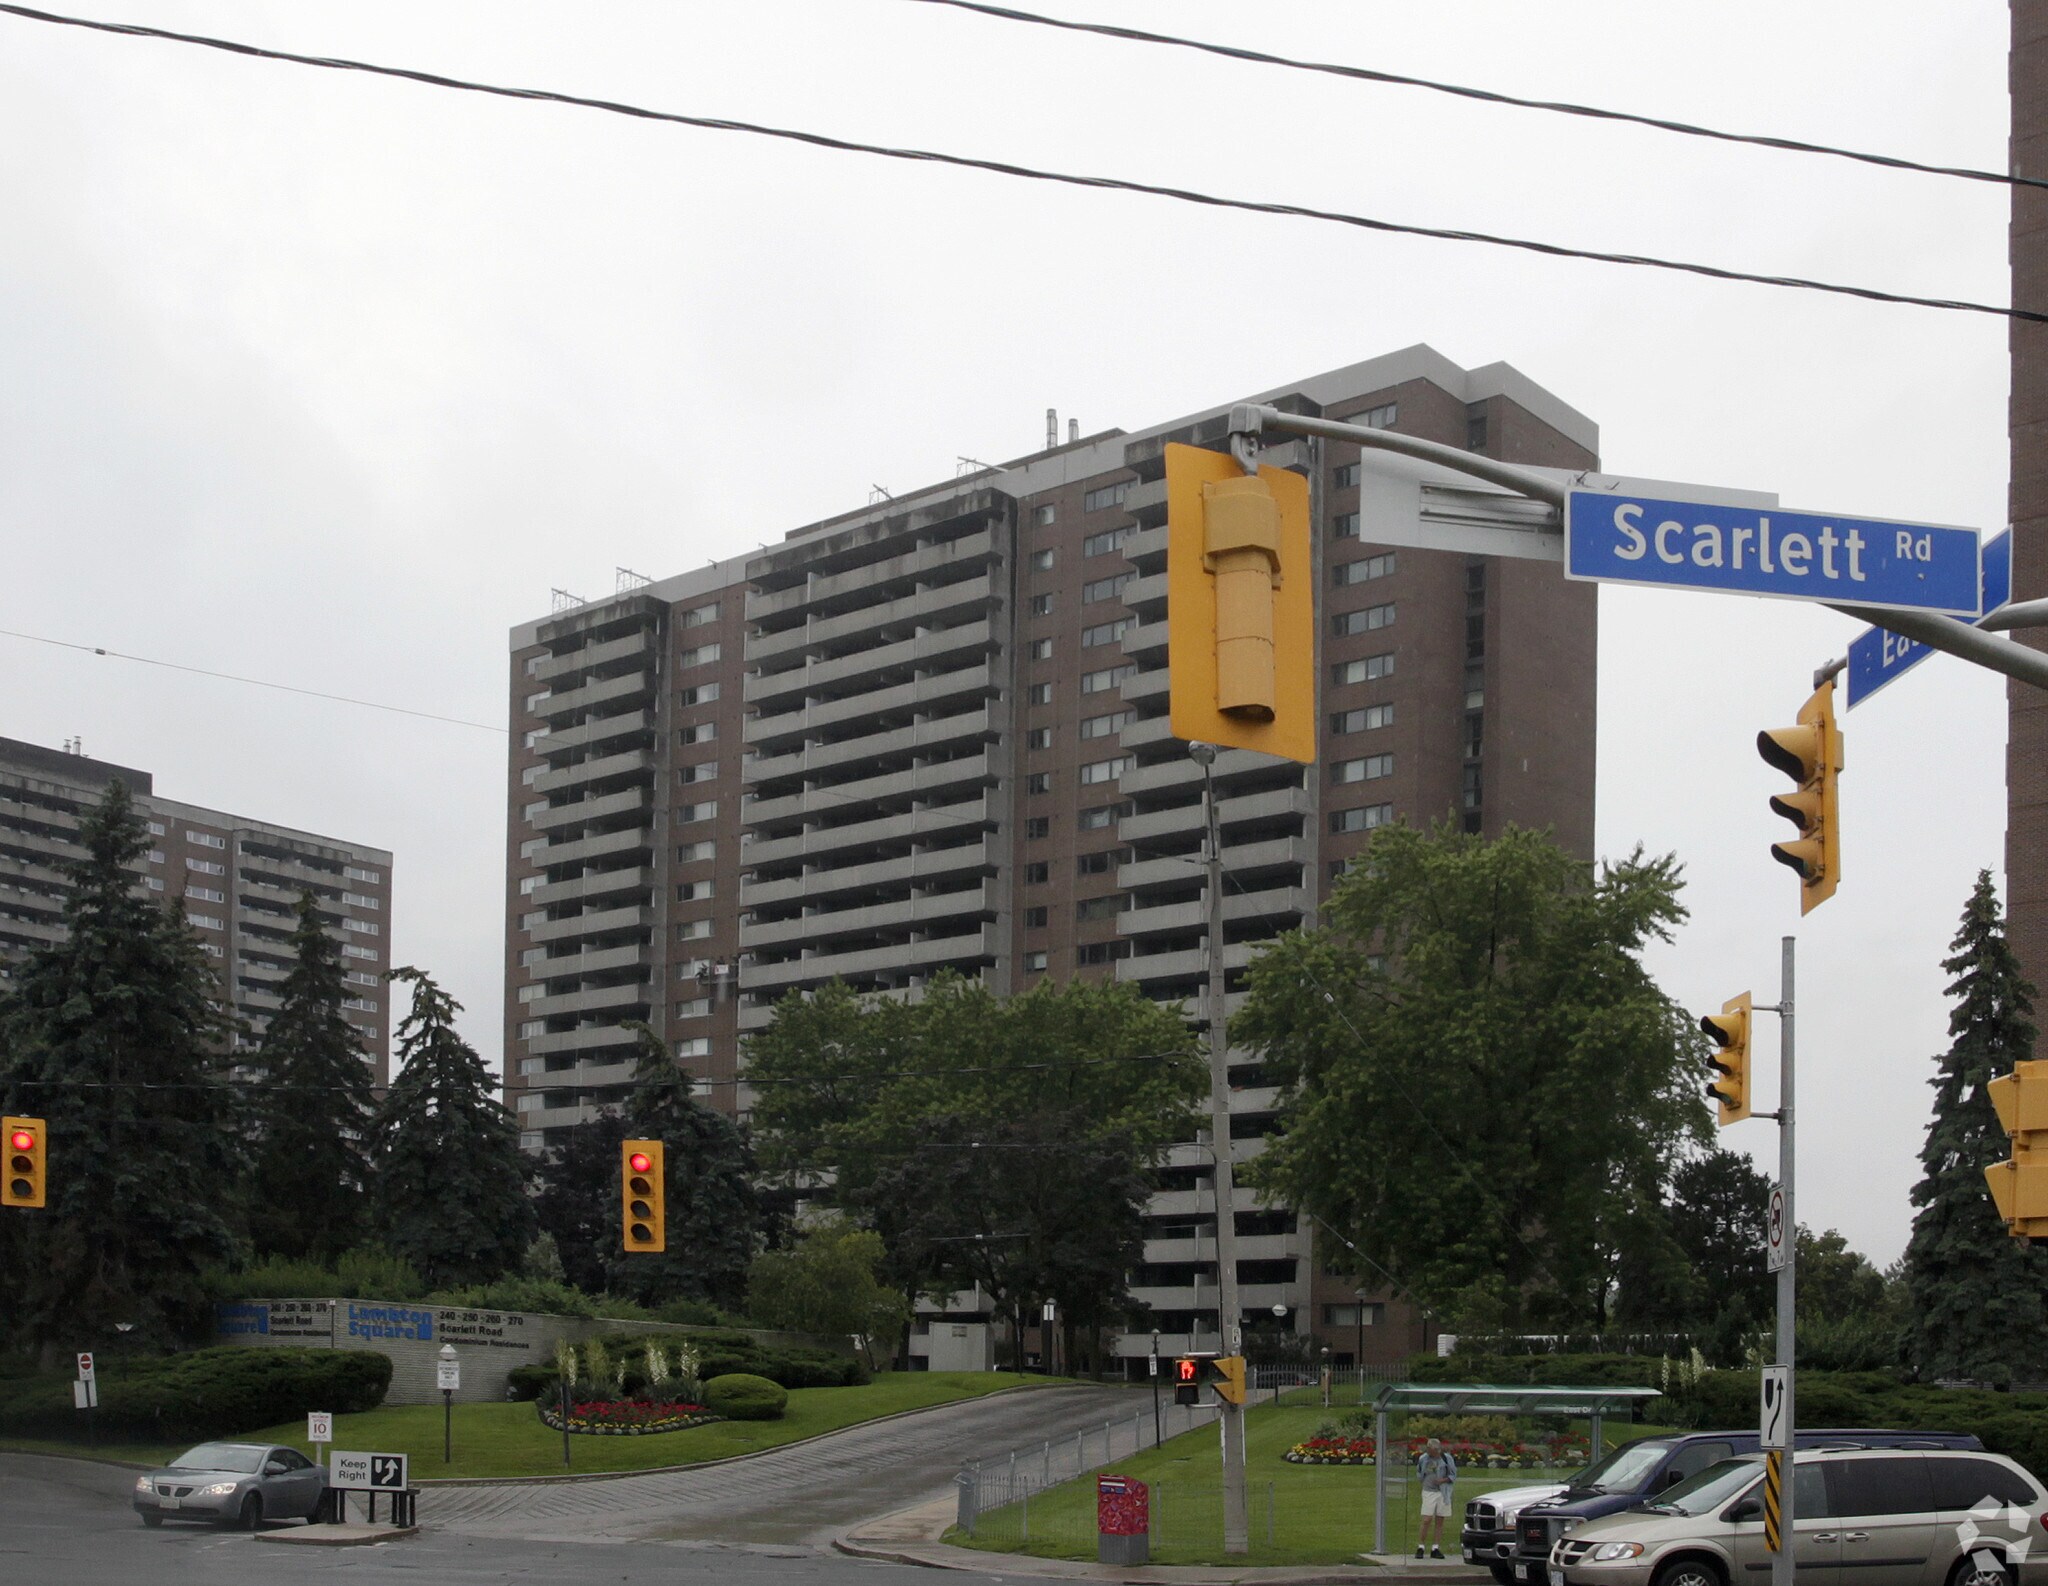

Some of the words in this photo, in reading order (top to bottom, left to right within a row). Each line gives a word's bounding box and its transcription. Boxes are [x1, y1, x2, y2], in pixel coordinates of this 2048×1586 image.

[1612, 503, 1866, 582] Scarlett
[1895, 531, 1932, 562] Rd
[1883, 628, 1921, 668] Ea
[348, 1304, 432, 1324] Lambton
[440, 1310, 455, 1321] 240
[463, 1312, 478, 1322] 250
[486, 1314, 501, 1324] 260
[508, 1316, 524, 1326] 270
[348, 1320, 415, 1341] Square
[439, 1322, 476, 1334] Scarlett
[479, 1326, 503, 1337] Road
[439, 1336, 488, 1347] Condominium
[313, 1423, 327, 1434] 10
[340, 1459, 367, 1469] Keep
[338, 1470, 366, 1481] Right
